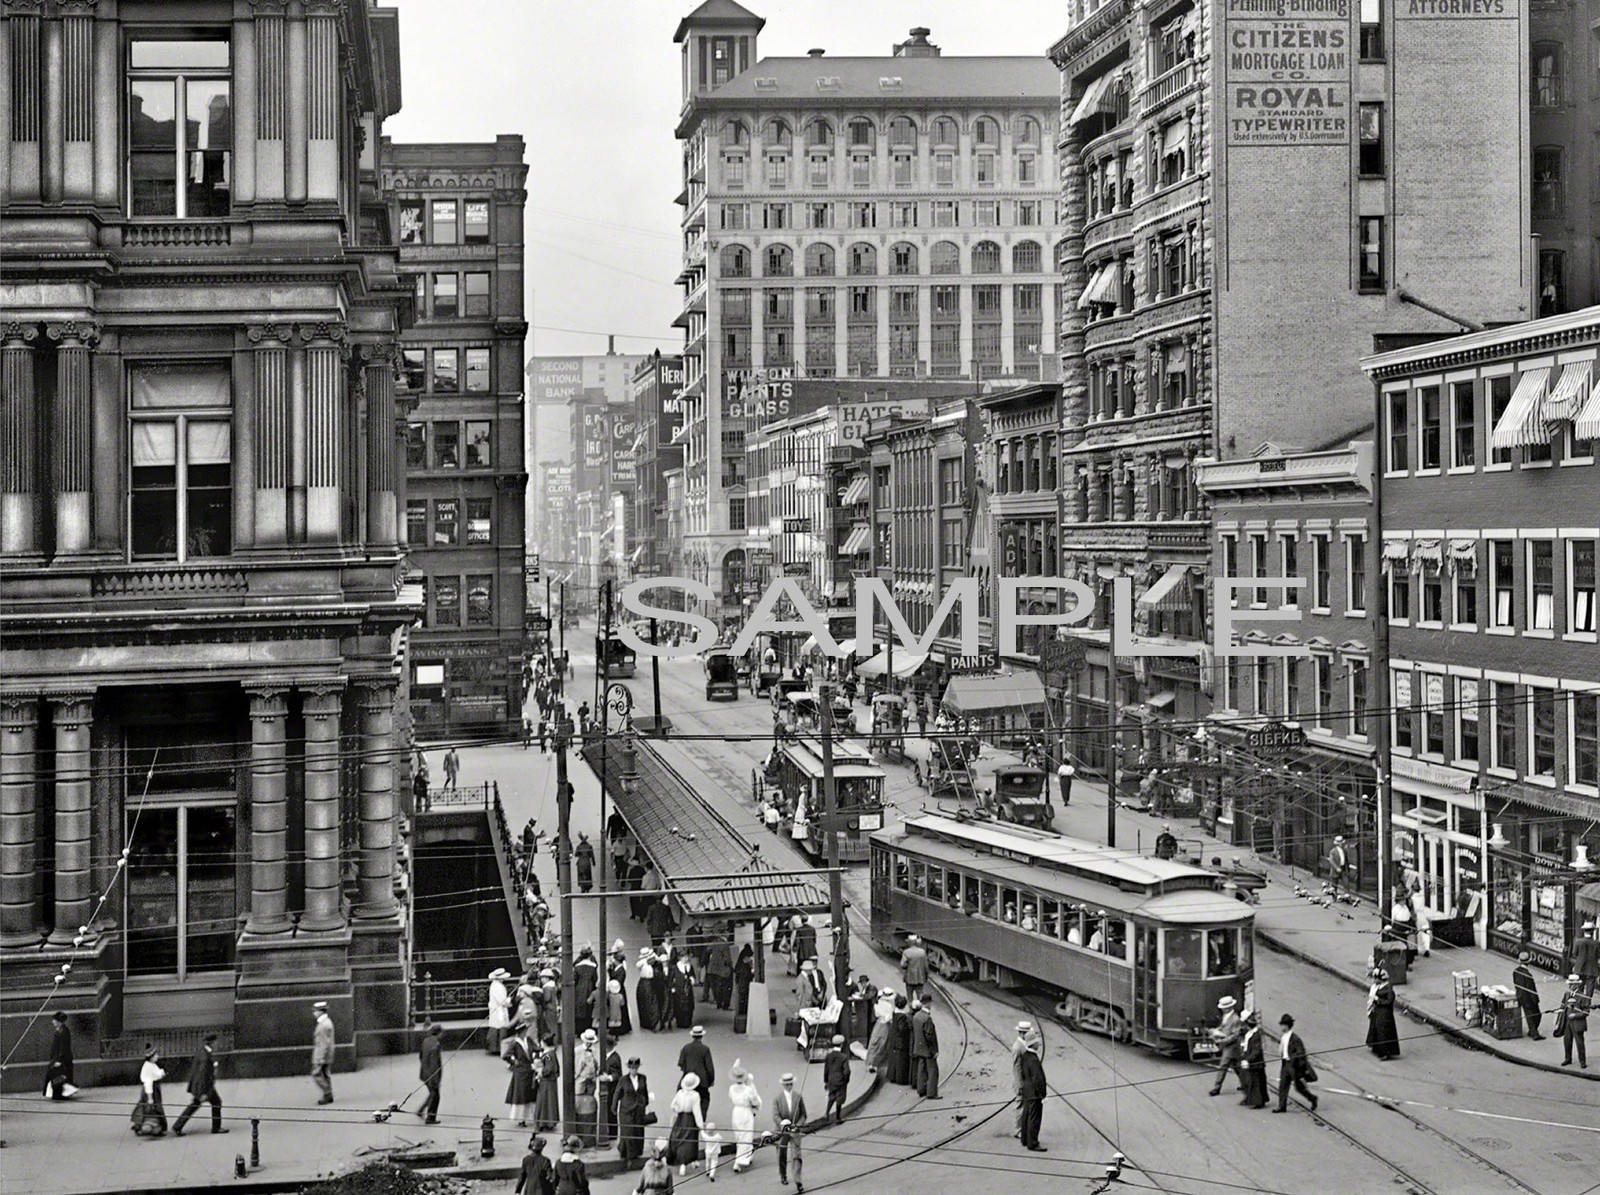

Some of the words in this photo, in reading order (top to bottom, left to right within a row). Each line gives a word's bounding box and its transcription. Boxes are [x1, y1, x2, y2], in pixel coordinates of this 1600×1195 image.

[1408, 0, 1504, 14] ATTORNEYS
[1232, 29, 1345, 48] CITIZENS
[1231, 53, 1305, 70] MORTGAGE
[1310, 53, 1345, 70] LOAN
[1271, 71, 1310, 79] CO.
[1236, 87, 1344, 108] ROYAL
[1231, 119, 1345, 131] TYPEWRITER
[1233, 132, 1250, 140] Used
[1252, 132, 1288, 142] extensively
[1290, 132, 1297, 142] by
[541, 361, 579, 371] SECOND
[537, 374, 582, 384] NATIONAL
[727, 368, 792, 382] WILSON
[545, 387, 576, 398] BANK
[727, 382, 792, 400] PAINTS
[729, 399, 789, 418] GLASS
[842, 405, 903, 422] HATS
[437, 503, 456, 511] SCOTT
[440, 513, 453, 521] LAW
[784, 520, 811, 532] TOYS
[950, 654, 996, 669] PAINTS
[1250, 731, 1300, 746] SIEFKE
[1493, 937, 1519, 955] DRUGS
